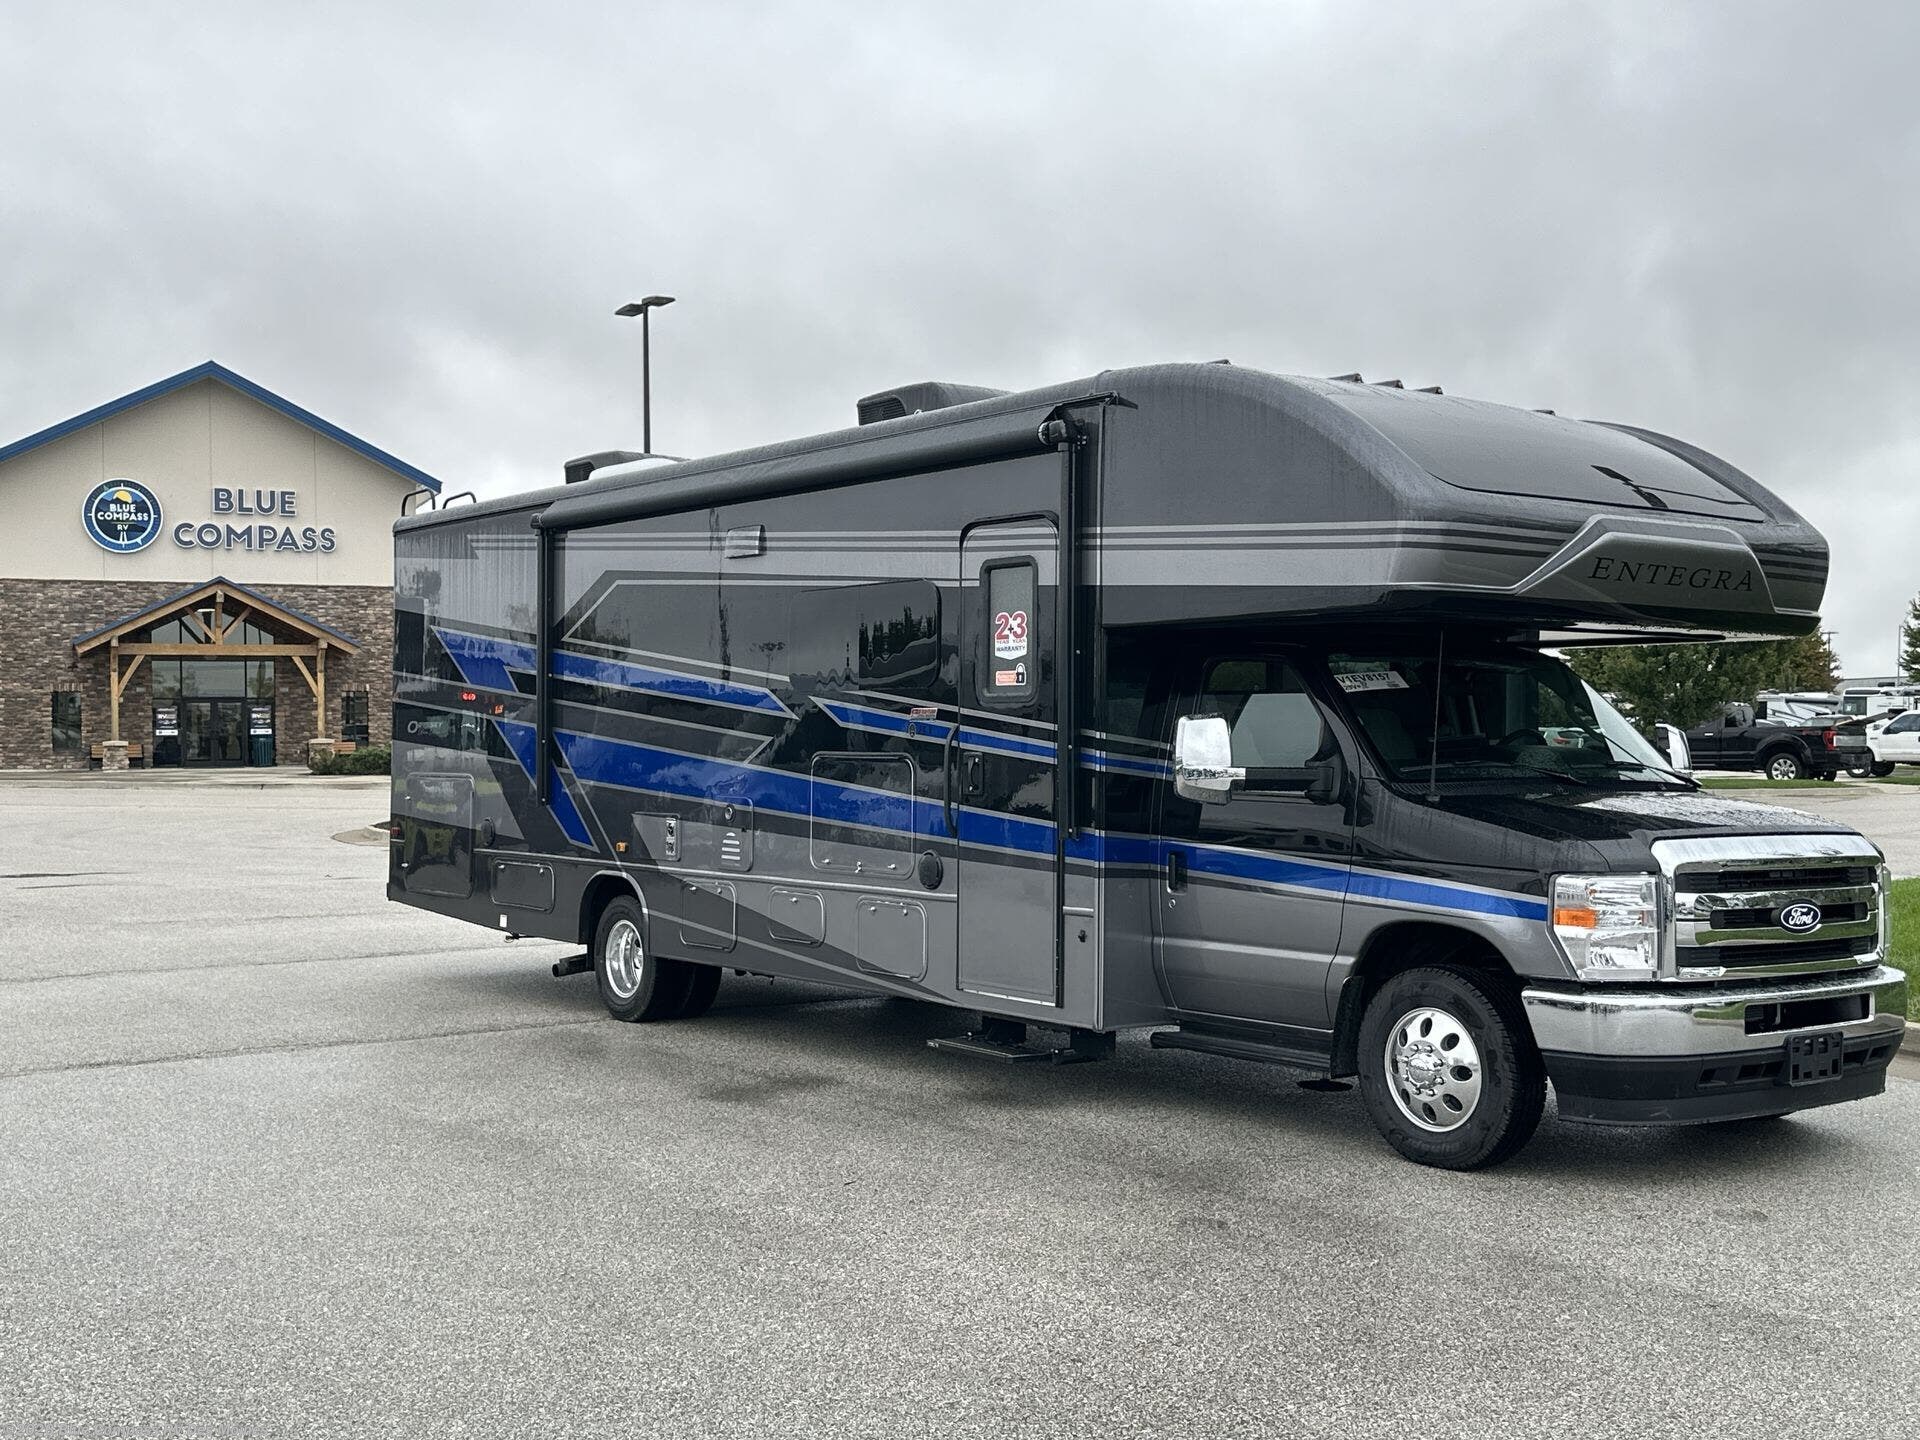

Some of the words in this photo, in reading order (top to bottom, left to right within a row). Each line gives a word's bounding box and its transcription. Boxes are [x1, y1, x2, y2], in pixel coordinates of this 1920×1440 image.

[109, 503, 136, 513] BLUE
[212, 486, 297, 516] BLUE
[97, 511, 149, 522] COMPASS
[173, 522, 337, 552] COMPASS
[1587, 556, 1753, 592] ENTEGRA
[1788, 907, 1814, 925] Ford
